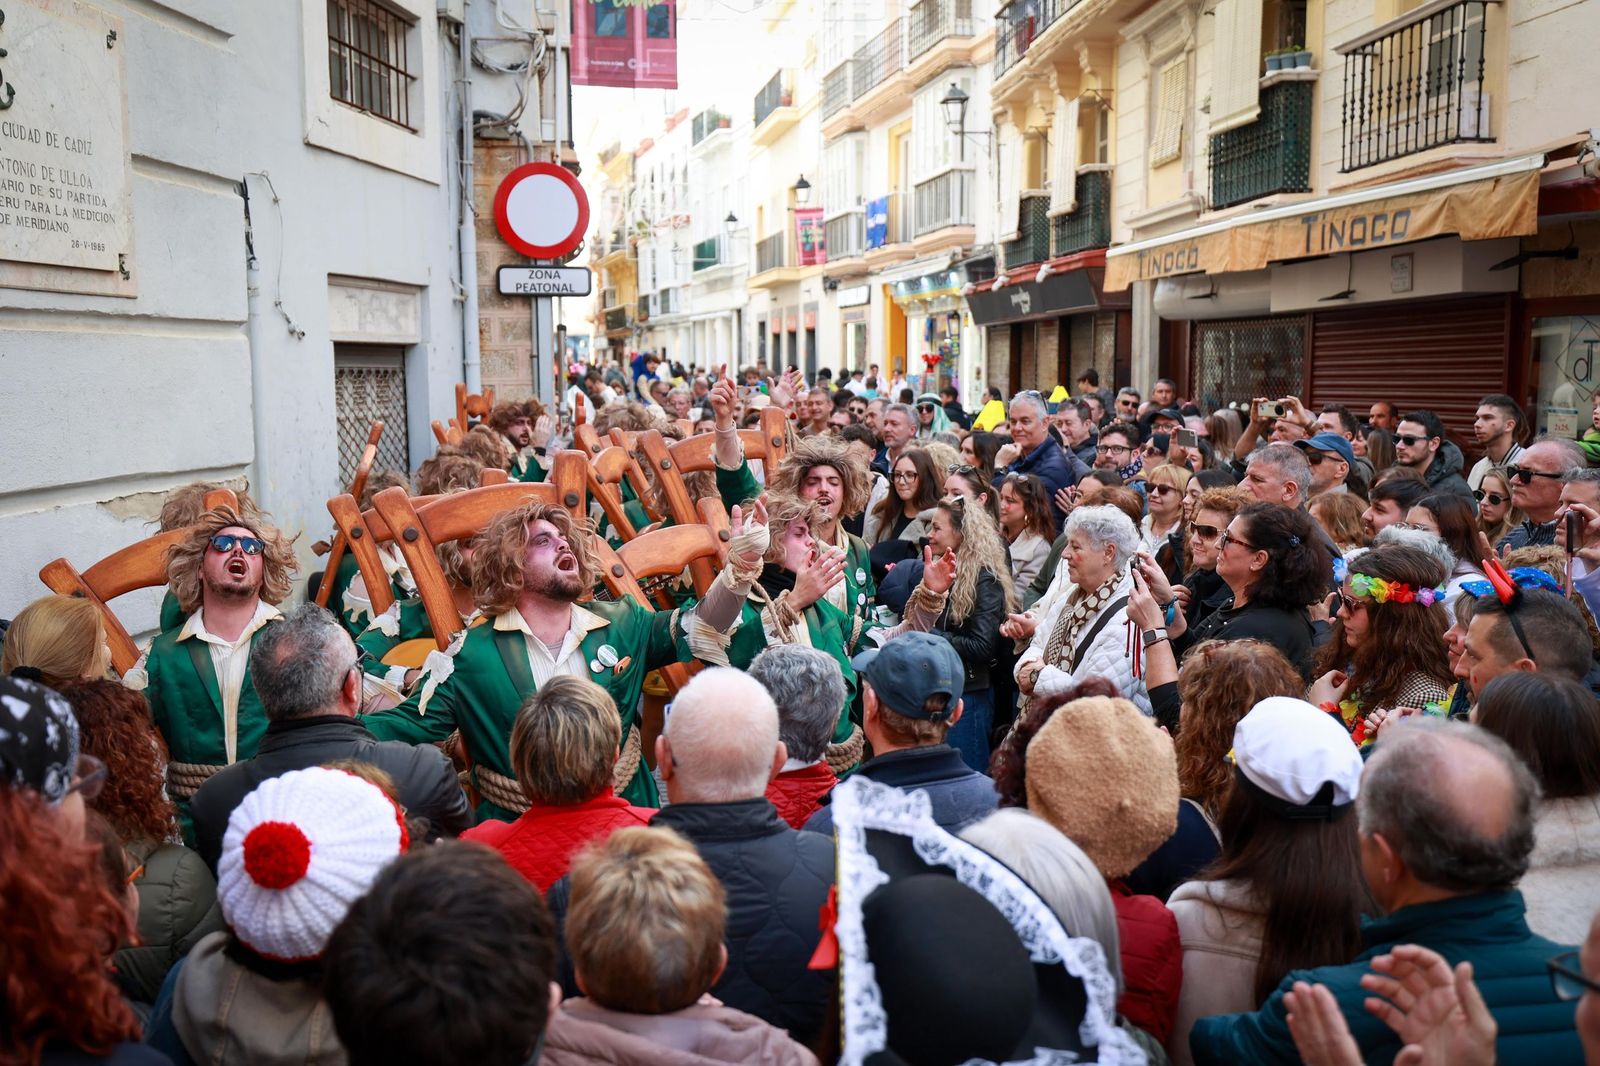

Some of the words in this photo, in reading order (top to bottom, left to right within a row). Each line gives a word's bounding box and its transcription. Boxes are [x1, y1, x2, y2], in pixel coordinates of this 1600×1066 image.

[2, 121, 41, 144] CIUDAD
[46, 131, 60, 149] DE
[64, 136, 93, 156] CADIZ
[41, 165, 55, 183] DE
[60, 169, 93, 189] ULLOA
[1, 179, 25, 193] ARIO
[30, 183, 44, 196] DE
[49, 187, 63, 199] SU
[67, 190, 107, 208] PARTIDA
[24, 199, 51, 215] PARA
[55, 204, 68, 217] LA
[72, 208, 116, 224] MEDICION
[528, 269, 561, 280] ZONA
[515, 282, 575, 293] PEATONAL
